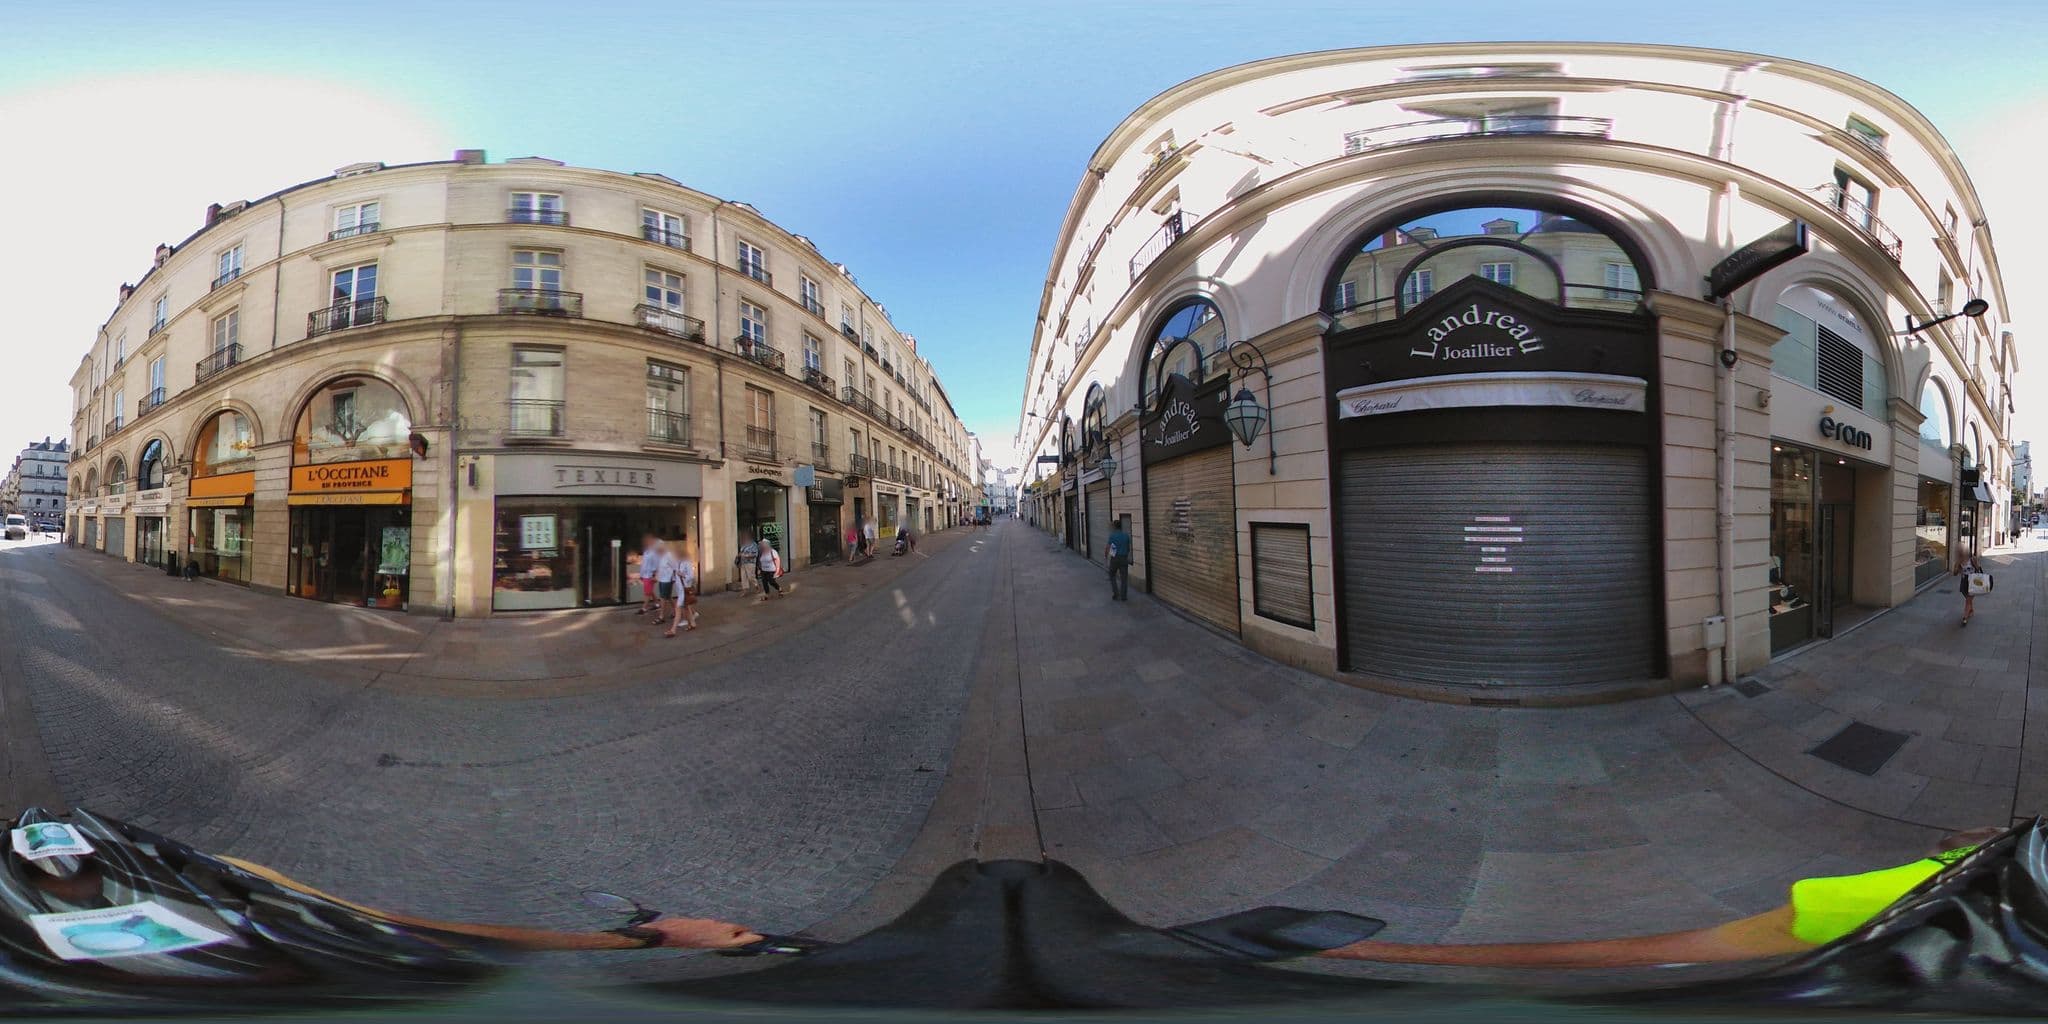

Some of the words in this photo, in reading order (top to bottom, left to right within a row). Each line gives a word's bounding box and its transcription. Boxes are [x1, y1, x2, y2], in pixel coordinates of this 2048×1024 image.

[1410, 304, 1544, 360] Landreau
[1442, 344, 1514, 360] Joaillier
[1218, 390, 1228, 402] 10
[1574, 389, 1632, 406] Chopard
[1350, 396, 1401, 413] Chopard
[1155, 398, 1200, 446] Landreau
[308, 465, 389, 481] L'OCCITANE
[555, 469, 656, 484] TEXIER
